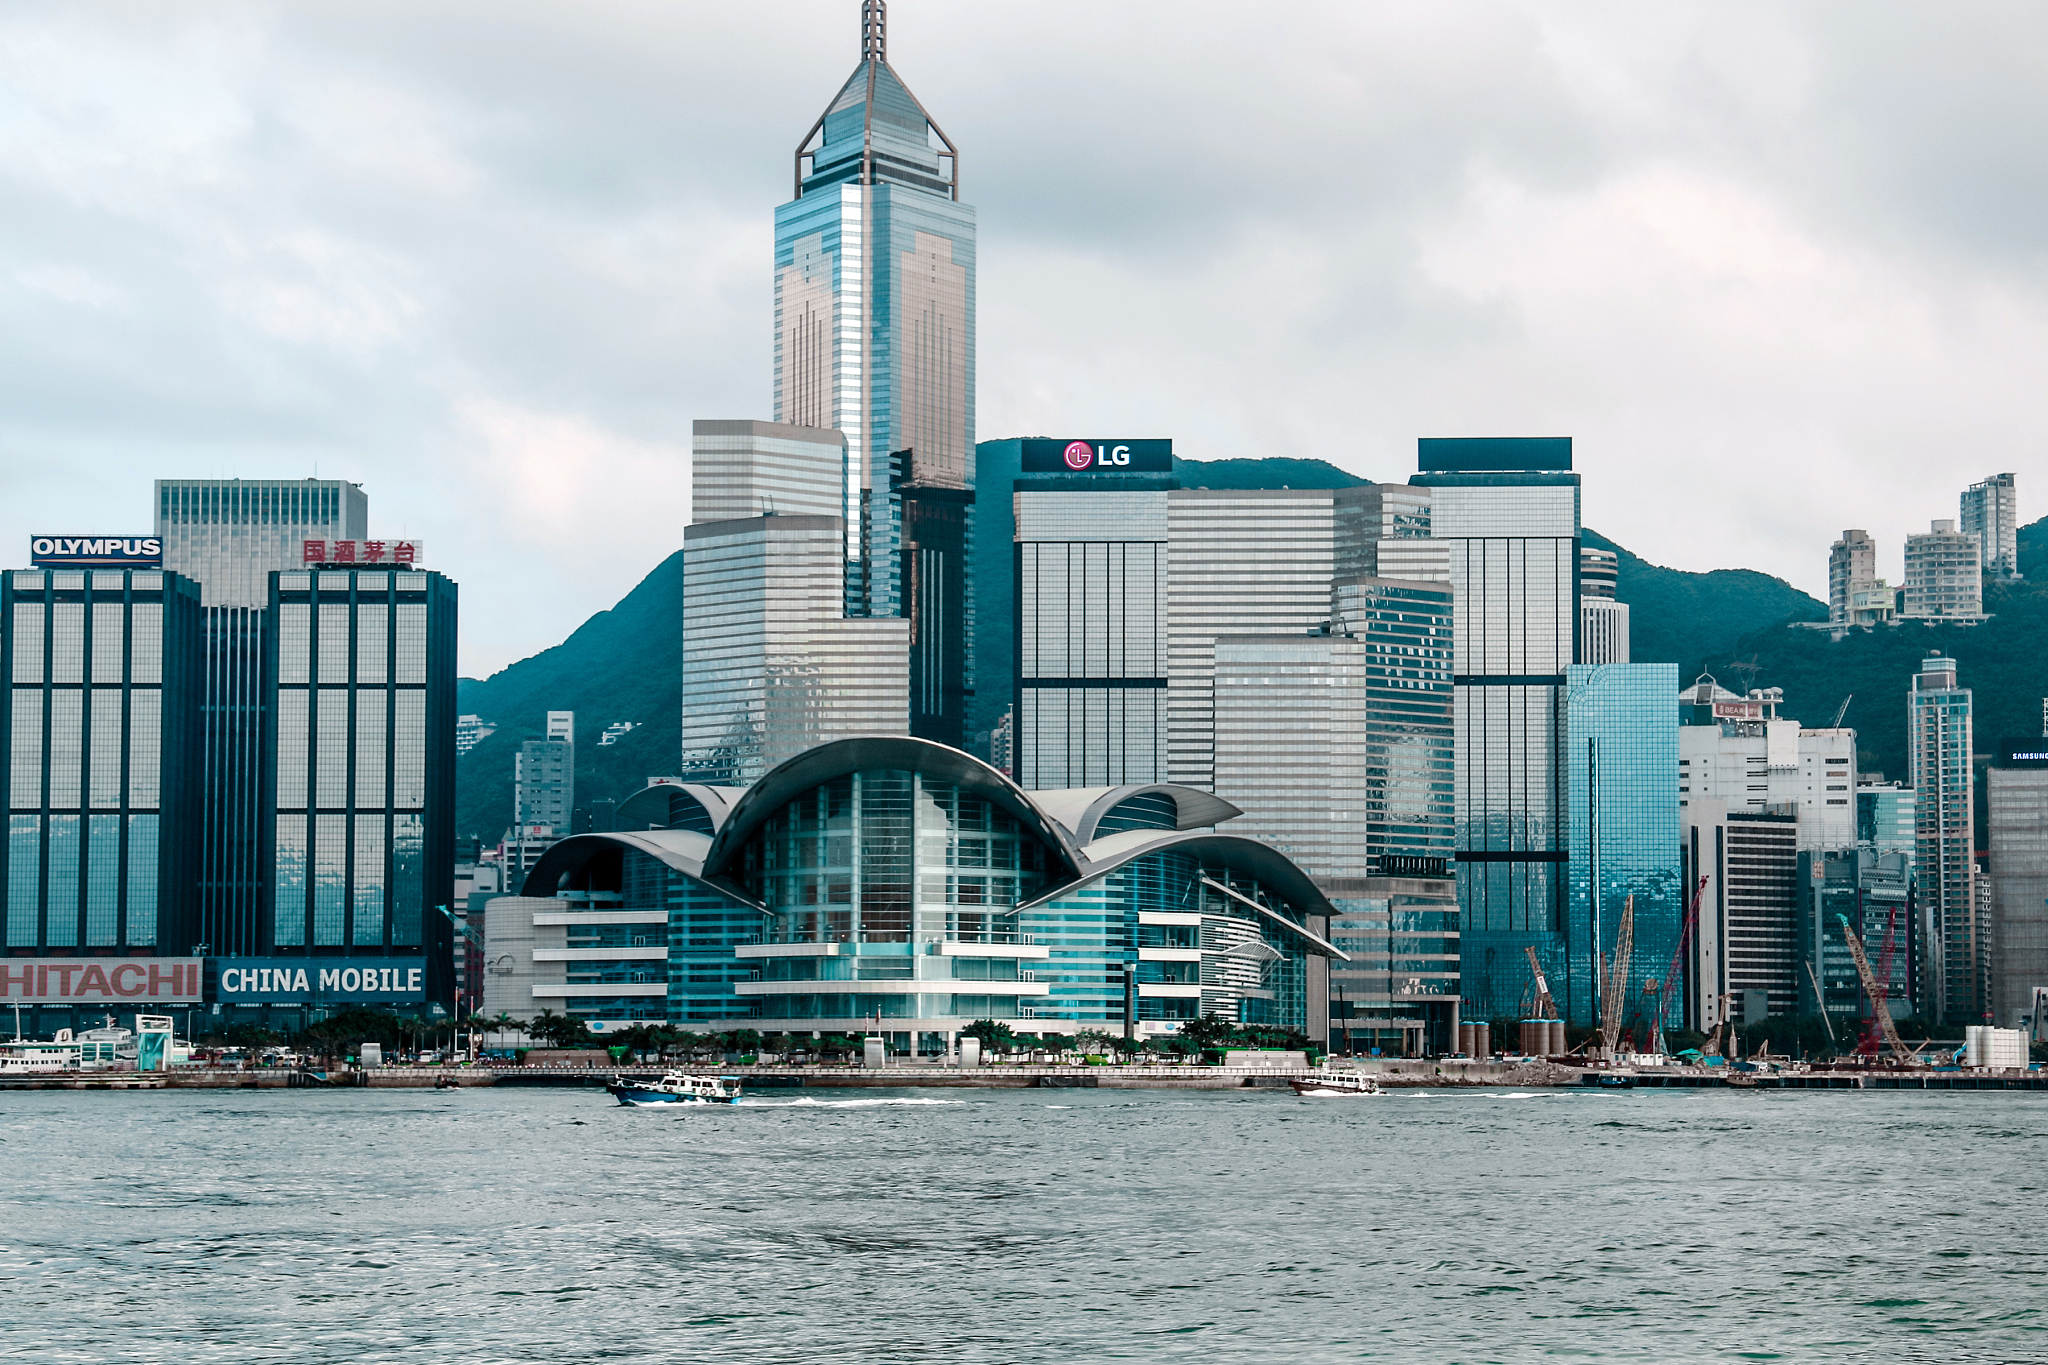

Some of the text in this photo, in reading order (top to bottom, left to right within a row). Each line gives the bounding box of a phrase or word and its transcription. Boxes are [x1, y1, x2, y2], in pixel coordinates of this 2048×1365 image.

[1098, 445, 1130, 466] LG
[32, 538, 161, 556] OLYMPUS
[303, 540, 415, 562] 国酒茅台
[0, 963, 198, 997] HITACHI
[221, 967, 422, 993] CHINA MOBILE
